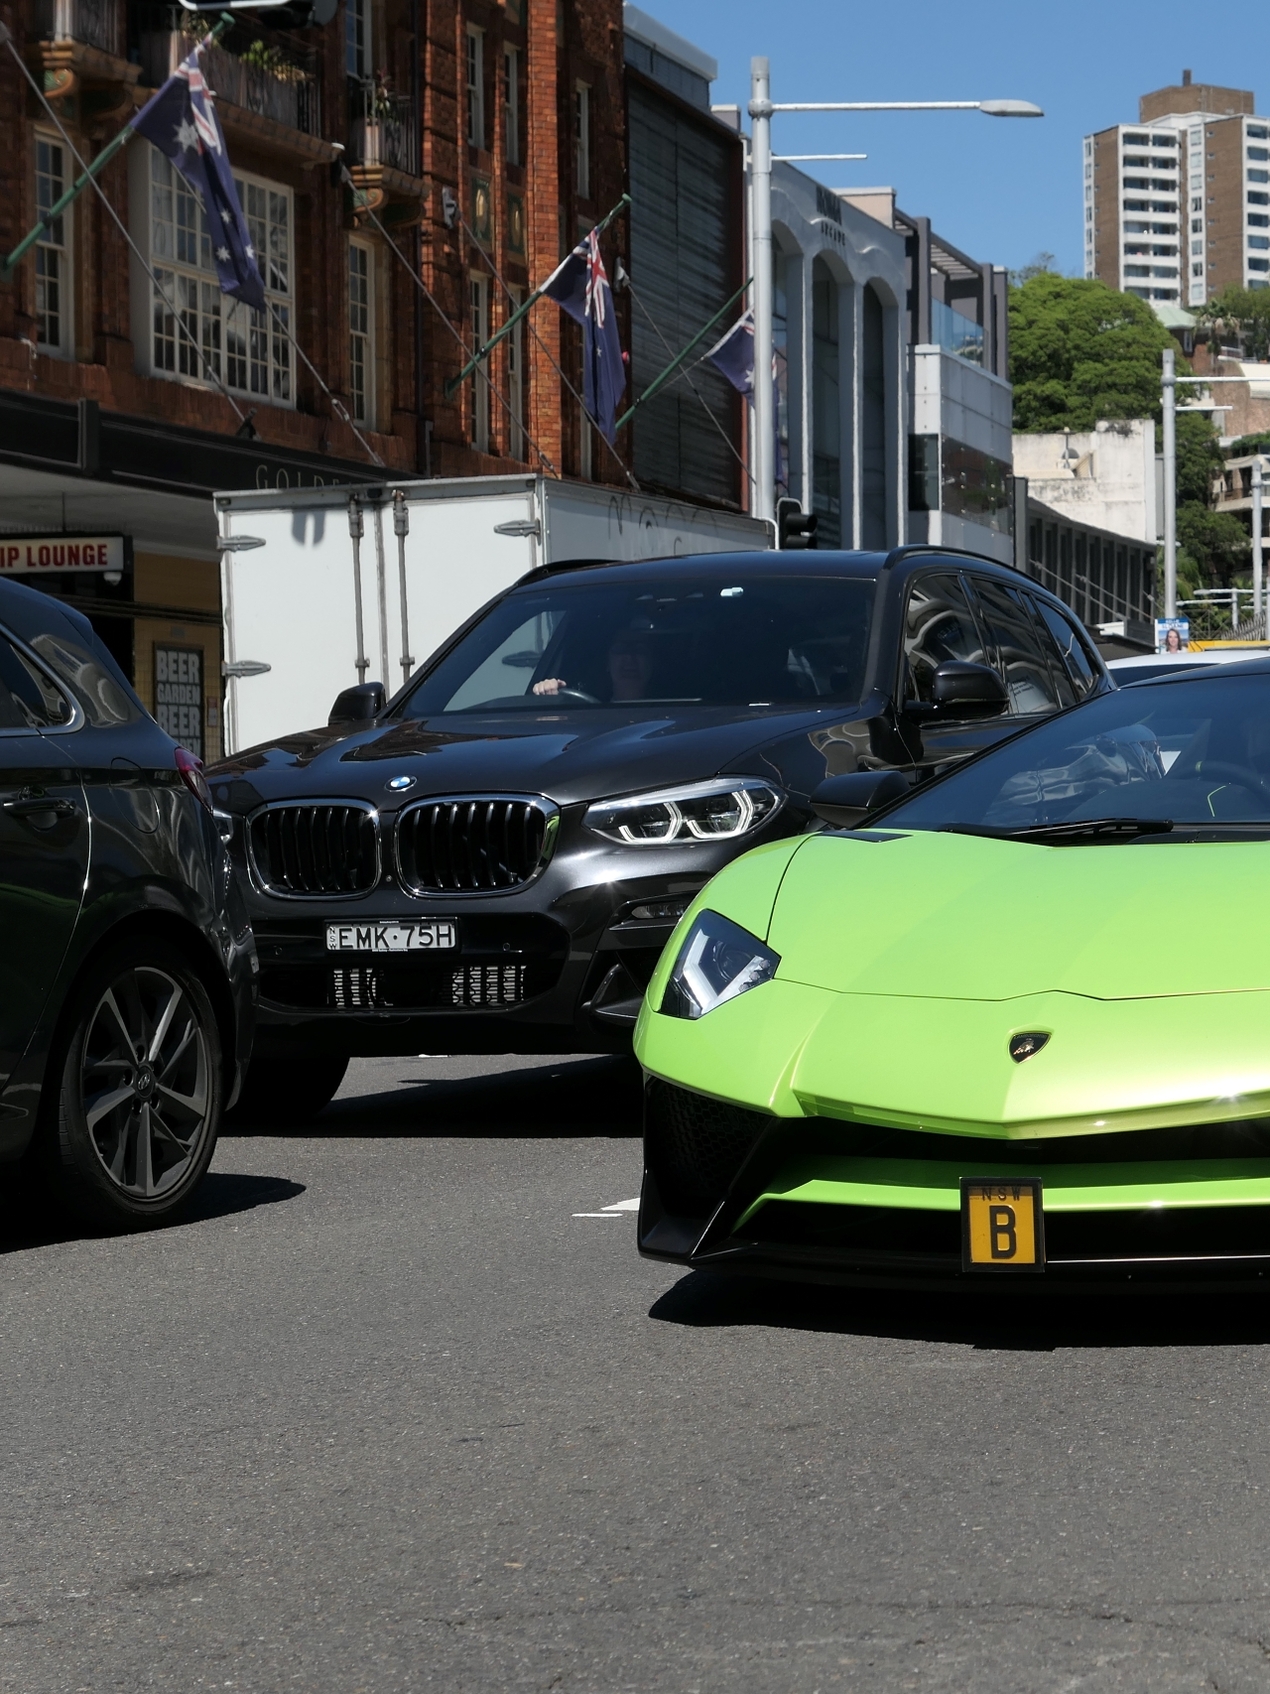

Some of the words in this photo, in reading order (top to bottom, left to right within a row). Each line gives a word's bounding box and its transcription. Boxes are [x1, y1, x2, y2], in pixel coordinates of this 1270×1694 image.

[26, 544, 108, 567] LOUNGE
[156, 650, 200, 683] BEER
[157, 682, 200, 705] GARDEN
[157, 704, 200, 736] BEER
[981, 1187, 1020, 1201] NSW
[989, 1205, 1017, 1260] B
